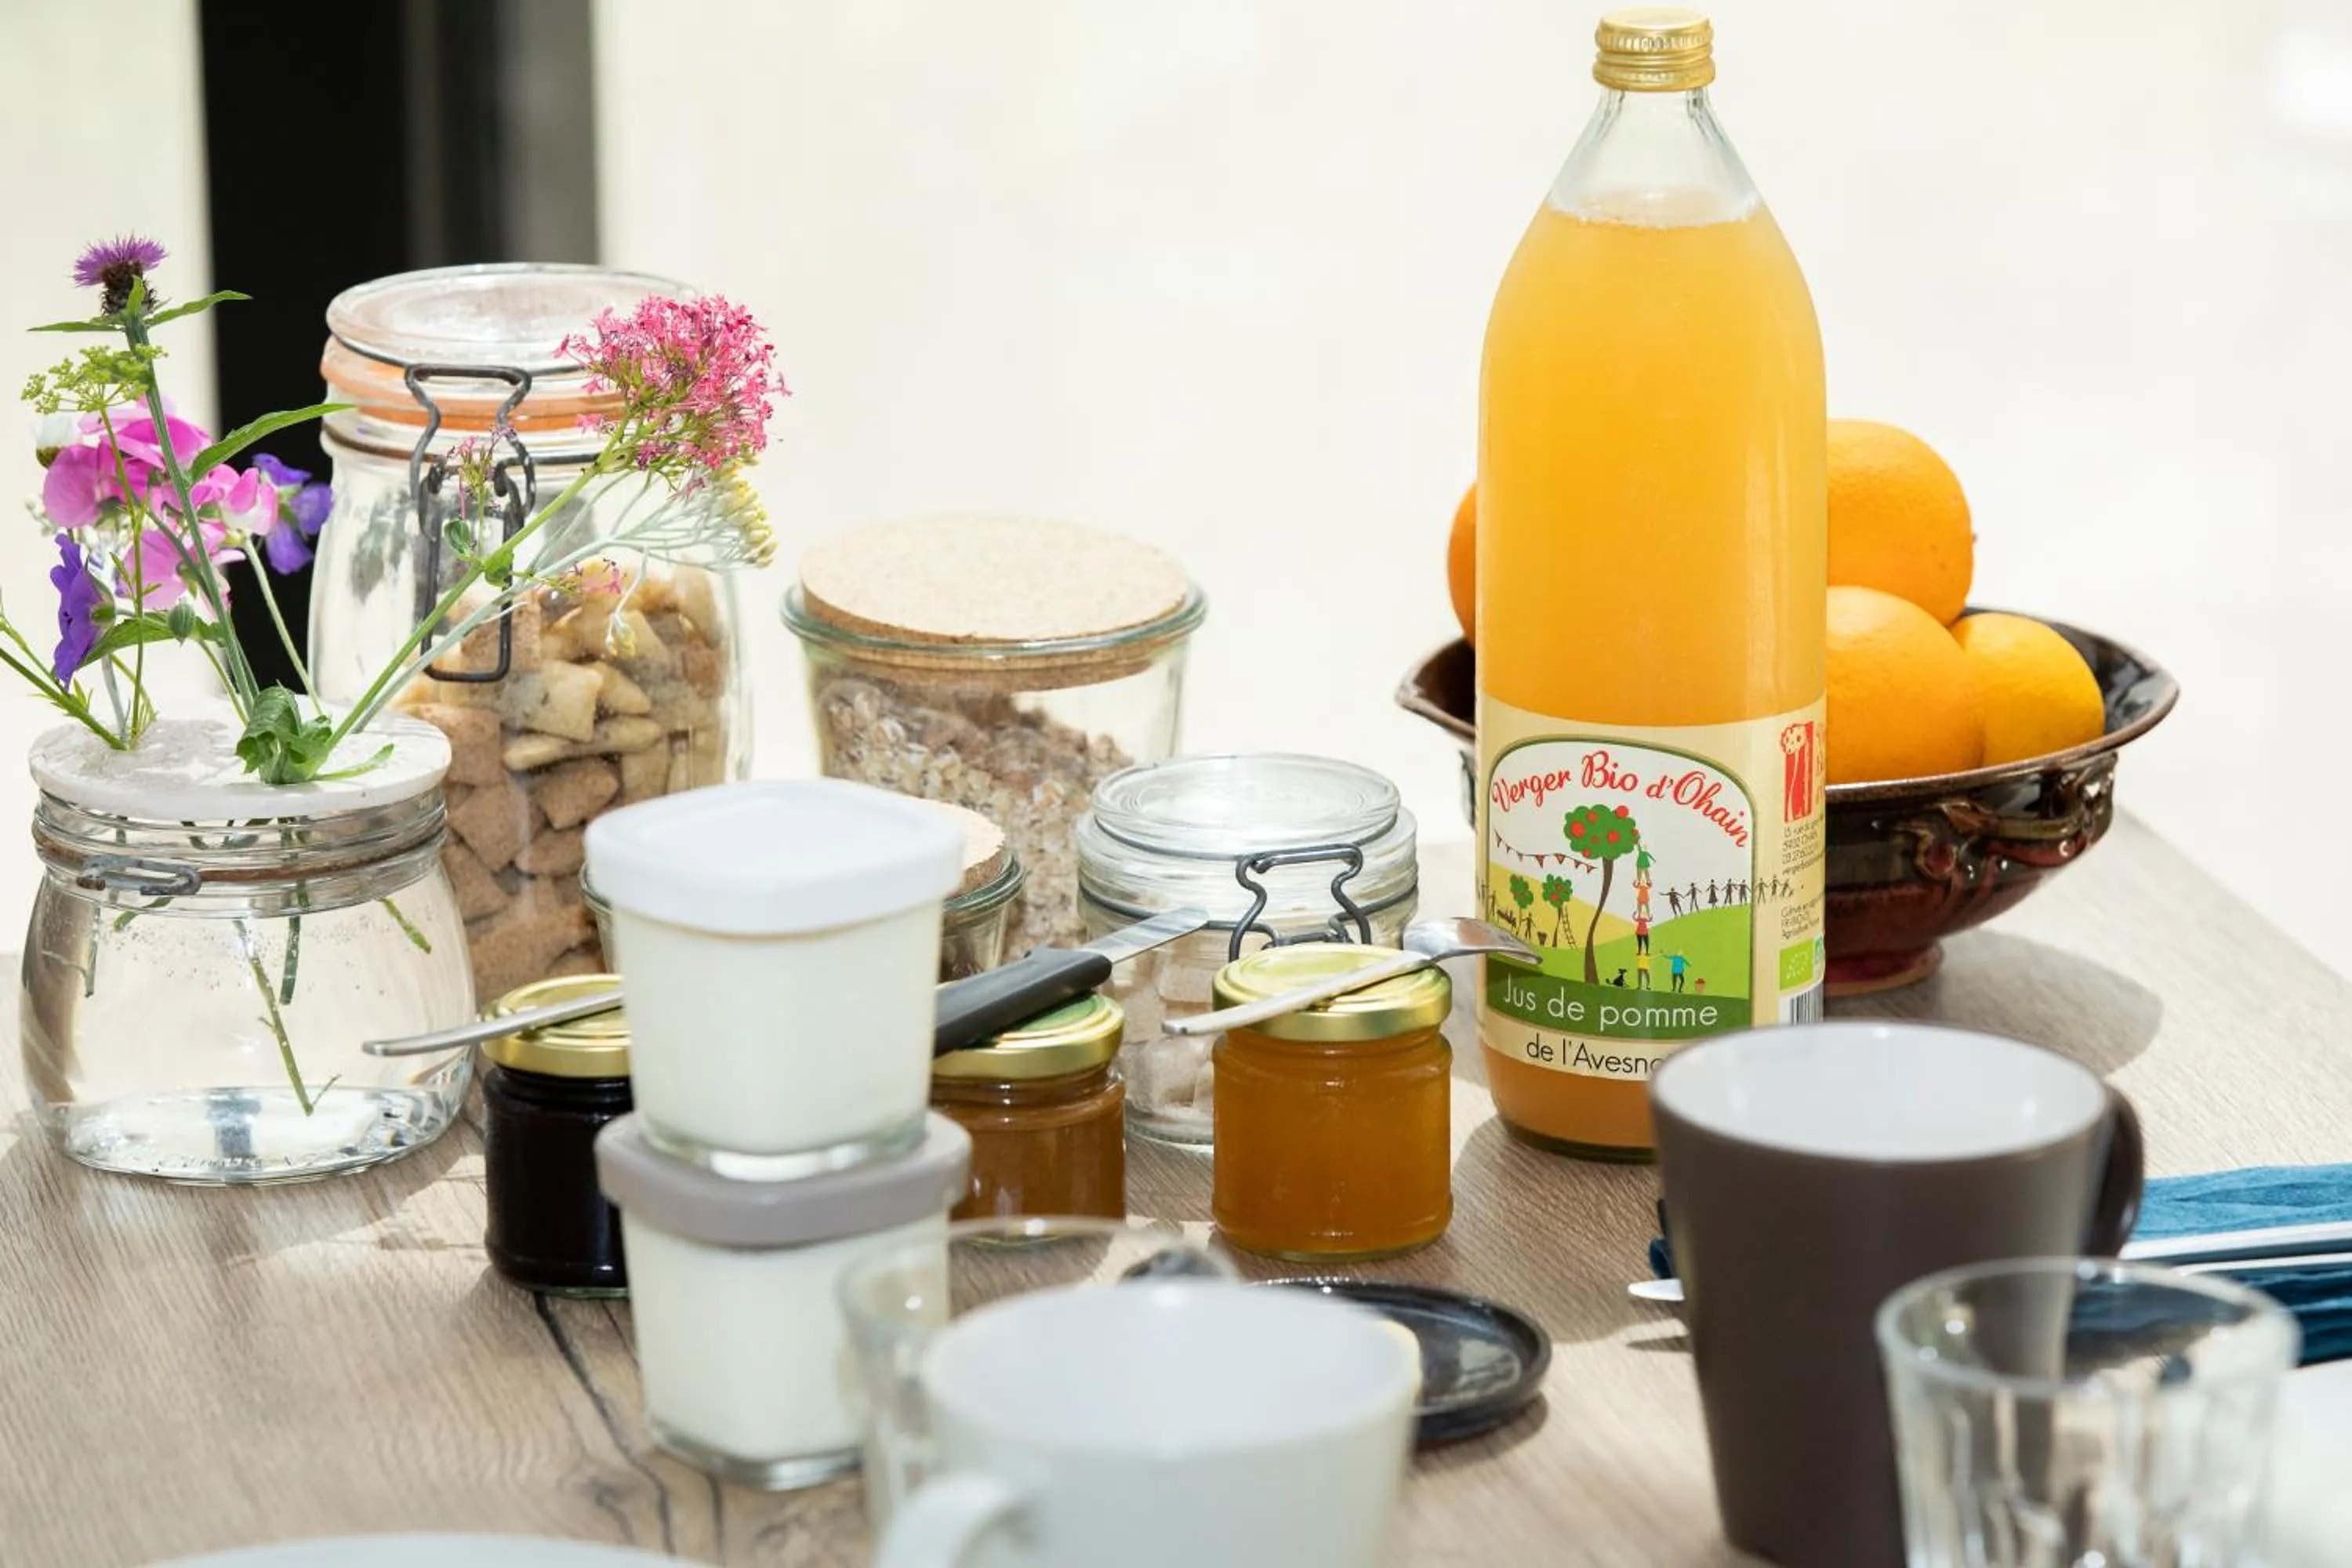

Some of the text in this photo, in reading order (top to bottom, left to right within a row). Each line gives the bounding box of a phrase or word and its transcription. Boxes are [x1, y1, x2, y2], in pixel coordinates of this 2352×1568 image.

[1491, 768, 1571, 812] Verger
[1581, 750, 1639, 792] Bio
[1646, 771, 1748, 848] d'Ohain
[1504, 972, 1719, 1032] Jus de pomme
[1526, 1033, 1555, 1062] de
